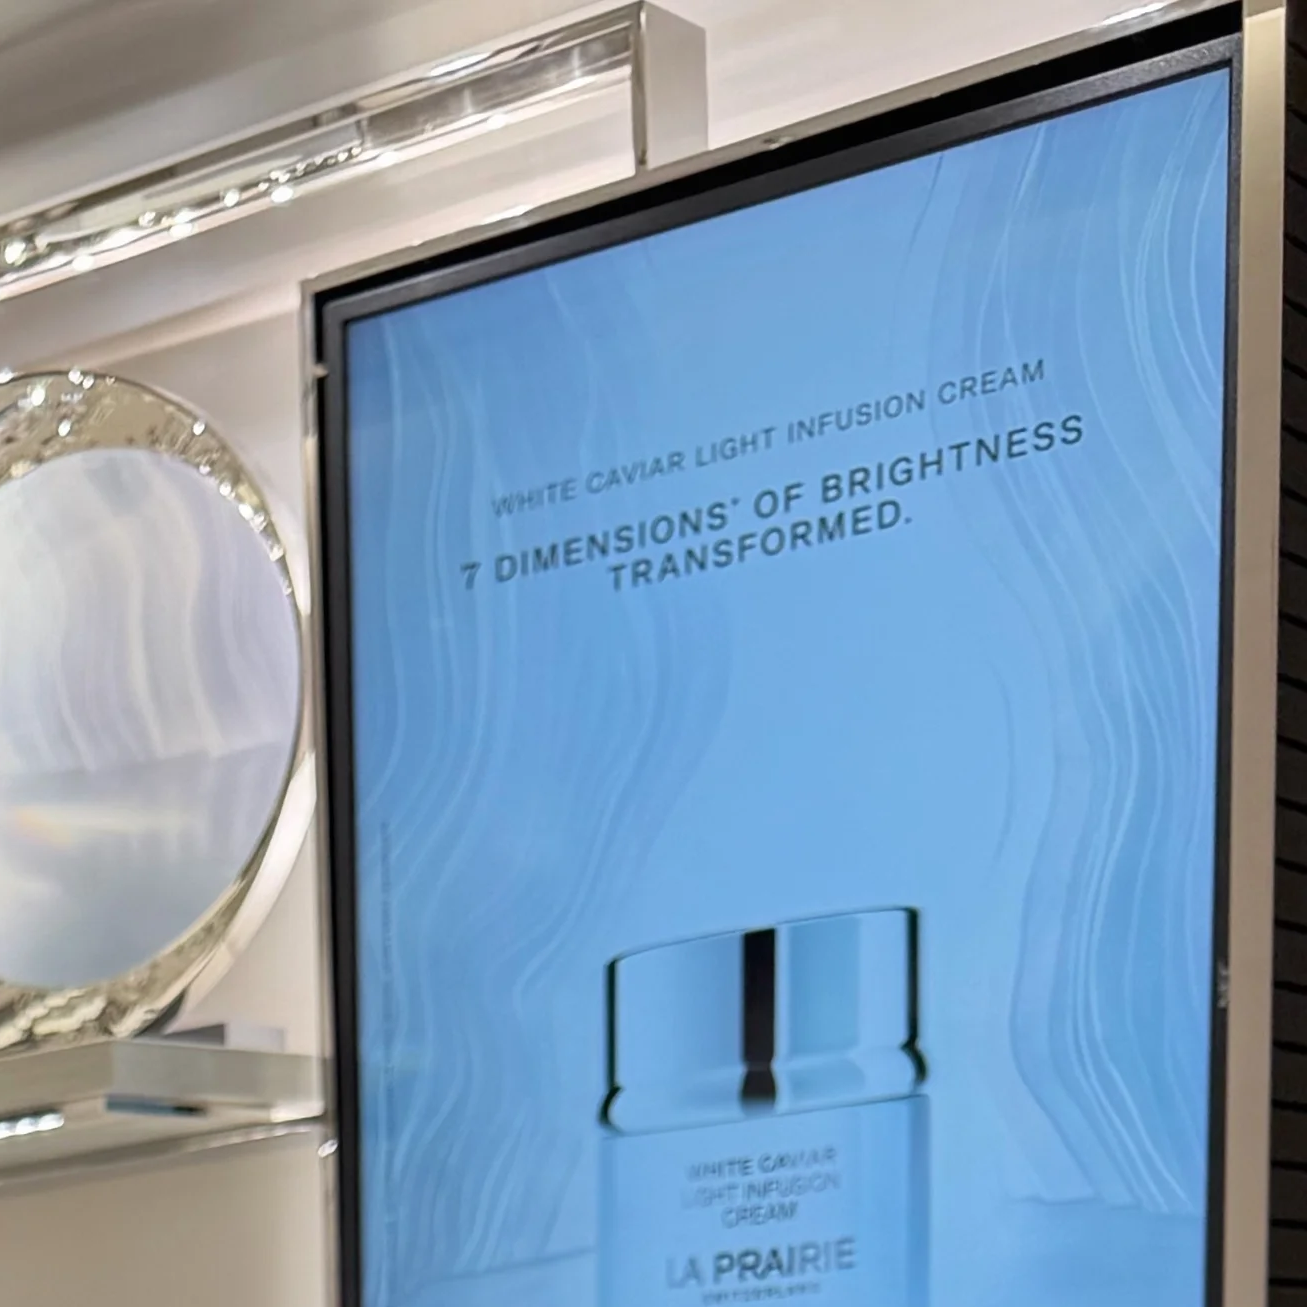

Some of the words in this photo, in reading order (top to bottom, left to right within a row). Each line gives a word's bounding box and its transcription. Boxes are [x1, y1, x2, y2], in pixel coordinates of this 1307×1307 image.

[460, 562, 482, 589] 7
[753, 482, 805, 518] OF
[821, 414, 1083, 502] BRIGHTNESS
[491, 480, 577, 519] WHITE
[586, 451, 686, 495] CAVIAR
[695, 428, 776, 468] LIGHT
[788, 389, 926, 444] INFUSION
[937, 358, 1046, 407] CREAM
[607, 499, 913, 592] TRANSFORMED.
[665, 1256, 703, 1290] LA
[712, 1236, 858, 1286] PRAIRIE
